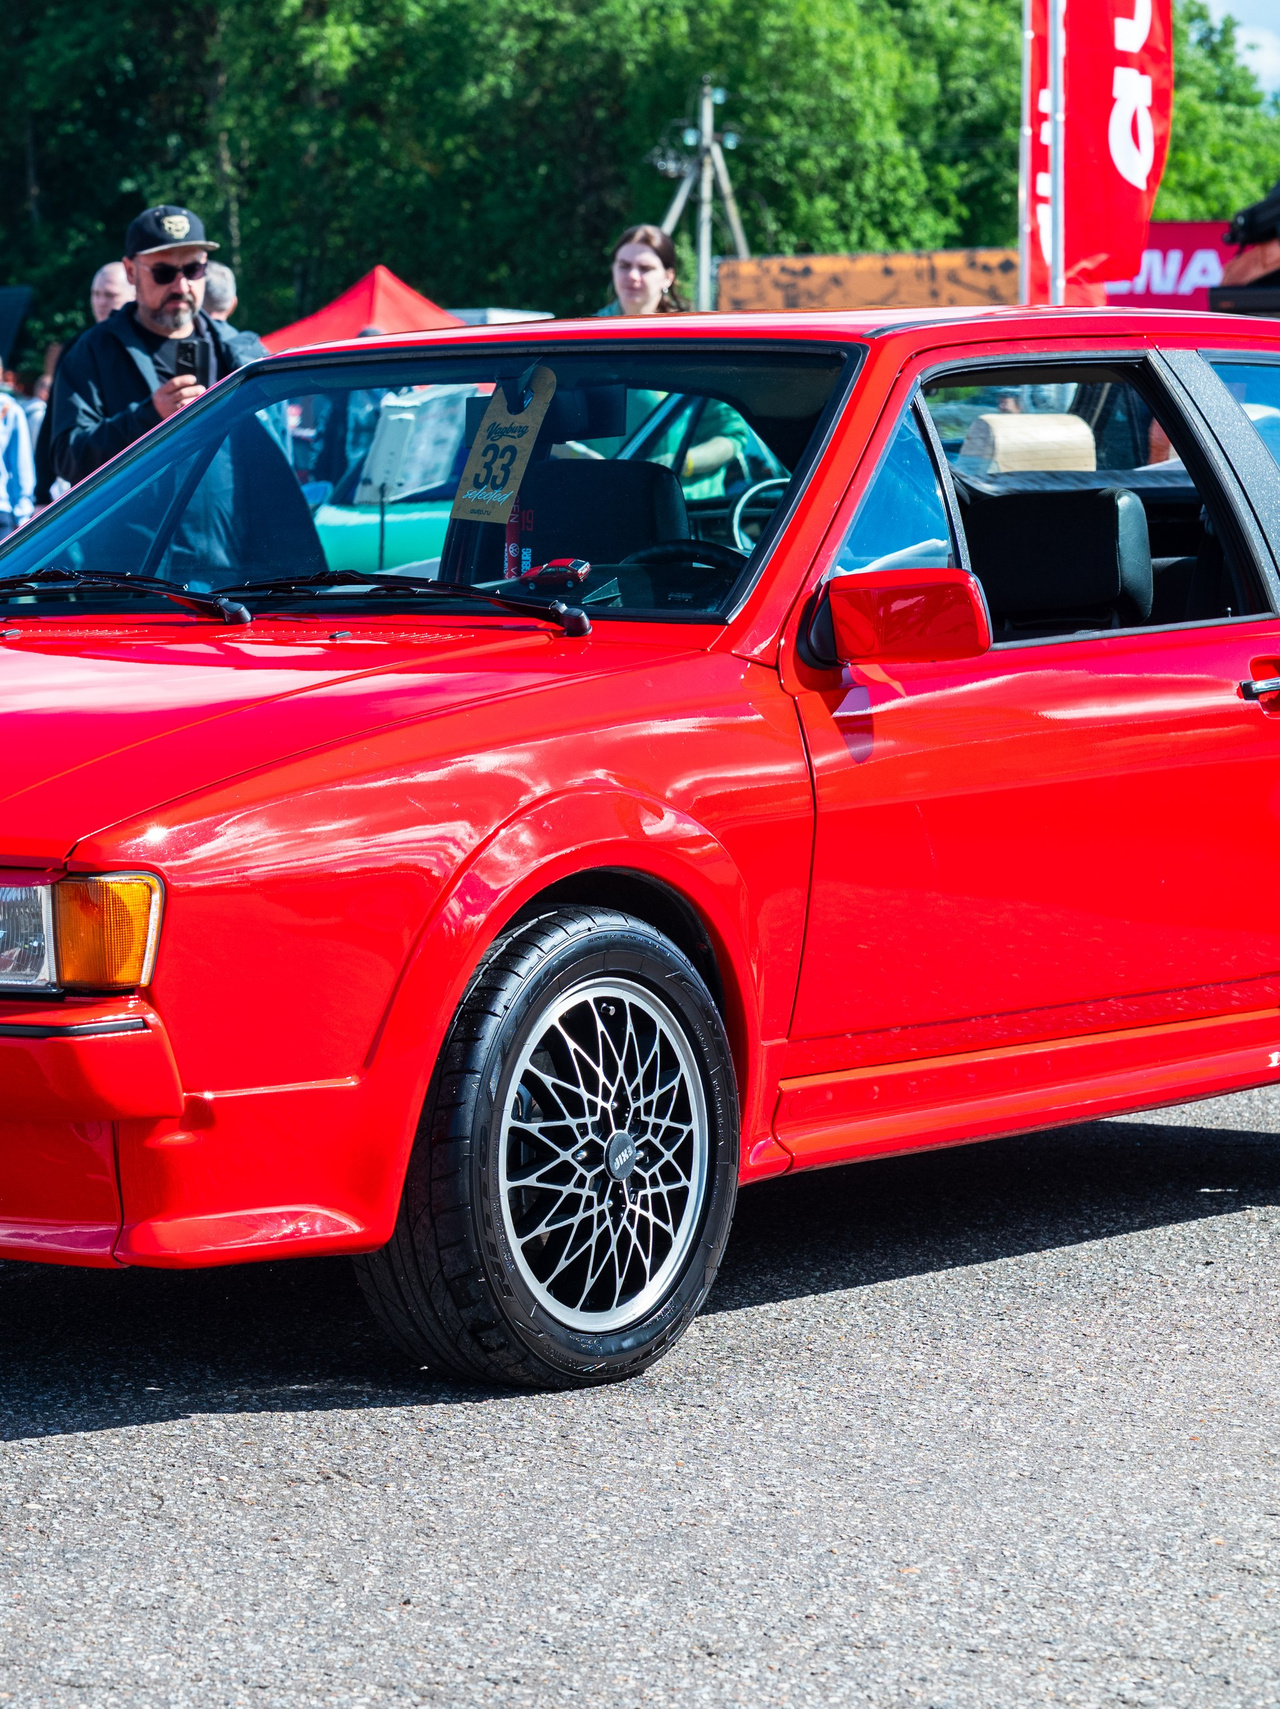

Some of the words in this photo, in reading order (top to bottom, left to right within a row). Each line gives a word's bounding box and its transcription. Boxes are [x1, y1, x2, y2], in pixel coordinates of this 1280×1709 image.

[1105, 248, 1224, 295] NA
[486, 421, 529, 442] Vagburg
[473, 443, 518, 491] 33
[462, 485, 514, 506] selected
